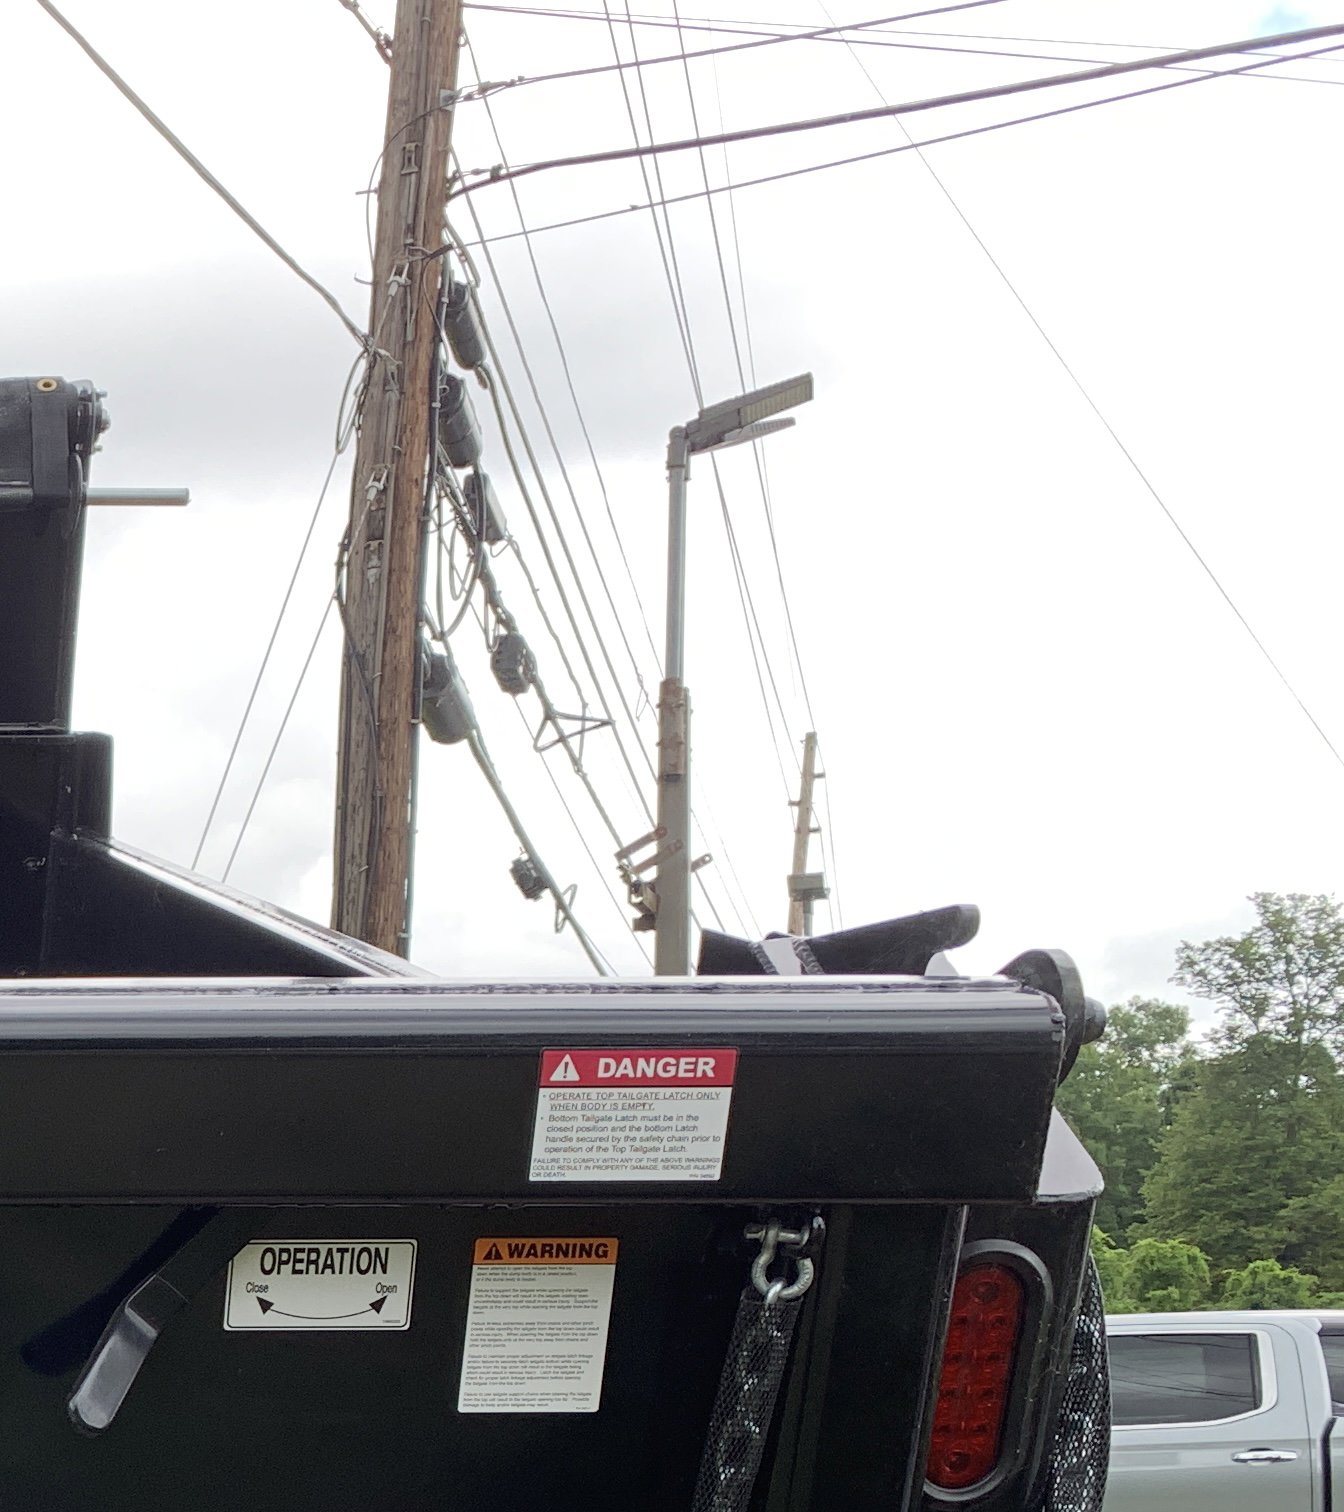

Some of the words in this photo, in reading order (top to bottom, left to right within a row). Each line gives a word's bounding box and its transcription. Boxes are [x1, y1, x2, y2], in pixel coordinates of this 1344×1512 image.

[597, 1057, 716, 1079] DANGER
[548, 1092, 592, 1100] OPERATE
[596, 1092, 615, 1100] TOP
[617, 1092, 660, 1100] TAILGATE
[663, 1092, 693, 1100] LATCH
[696, 1092, 721, 1100] ONLY
[550, 1102, 578, 1111] WHEN
[580, 1102, 607, 1111] BODY
[609, 1102, 619, 1111] IS
[548, 1114, 579, 1122] Bottom
[581, 1114, 612, 1124] Tailgate
[615, 1114, 638, 1122] Latch
[640, 1114, 661, 1122] must
[663, 1114, 673, 1122] be
[676, 1114, 684, 1122] in
[686, 1114, 699, 1122] the
[575, 1125, 608, 1134] position
[545, 1135, 574, 1143] handle
[575, 1135, 610, 1143] secured
[612, 1135, 622, 1144] by
[623, 1135, 637, 1143] the
[639, 1135, 665, 1144] safety
[666, 1135, 689, 1143] chain
[691, 1135, 710, 1144] prior
[713, 1135, 721, 1143] to
[544, 1146, 583, 1154] operation
[585, 1145, 594, 1153] of
[595, 1145, 609, 1153] the
[612, 1145, 627, 1154] Top
[629, 1145, 661, 1155] Tailgate
[507, 1243, 609, 1259] WARNING
[259, 1247, 390, 1275] OPERATION
[245, 1282, 269, 1294] Close
[375, 1282, 397, 1296] Open
